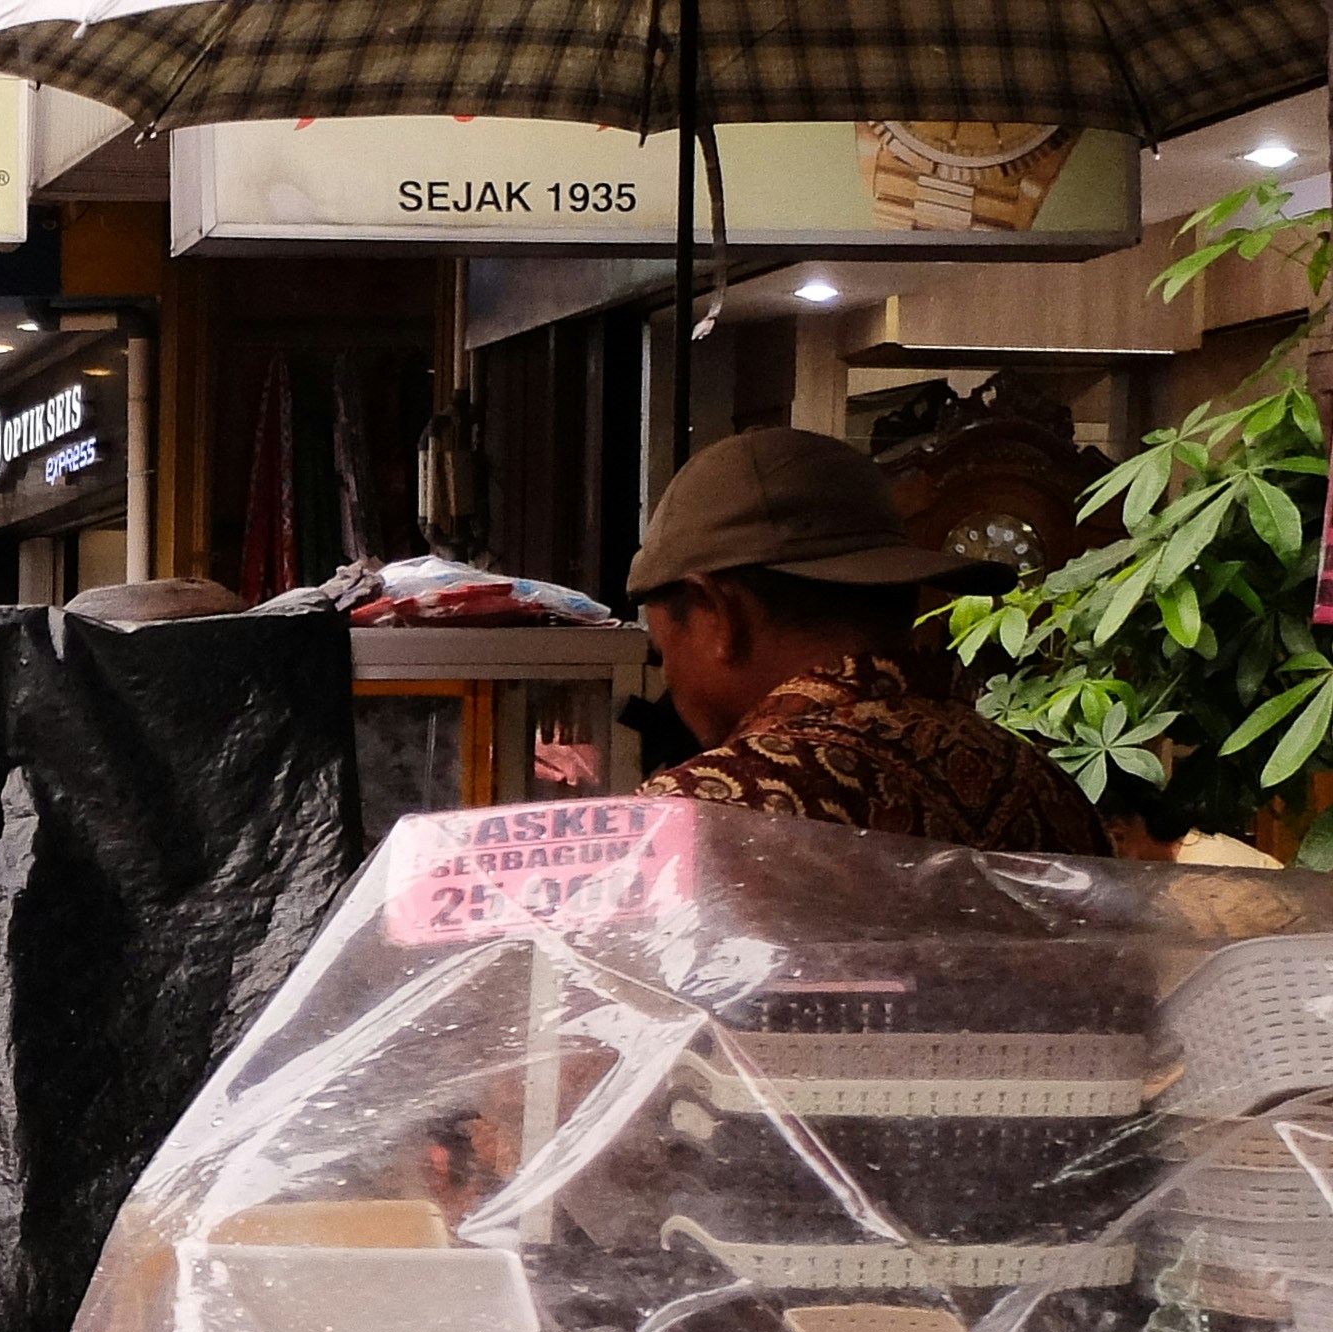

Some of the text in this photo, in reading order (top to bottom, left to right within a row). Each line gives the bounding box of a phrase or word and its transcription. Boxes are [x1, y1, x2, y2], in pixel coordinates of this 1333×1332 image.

[398, 180, 637, 212] SEJAK 1935
[4, 385, 82, 462] OPTIK SEIS
[443, 805, 648, 844] ASKET
